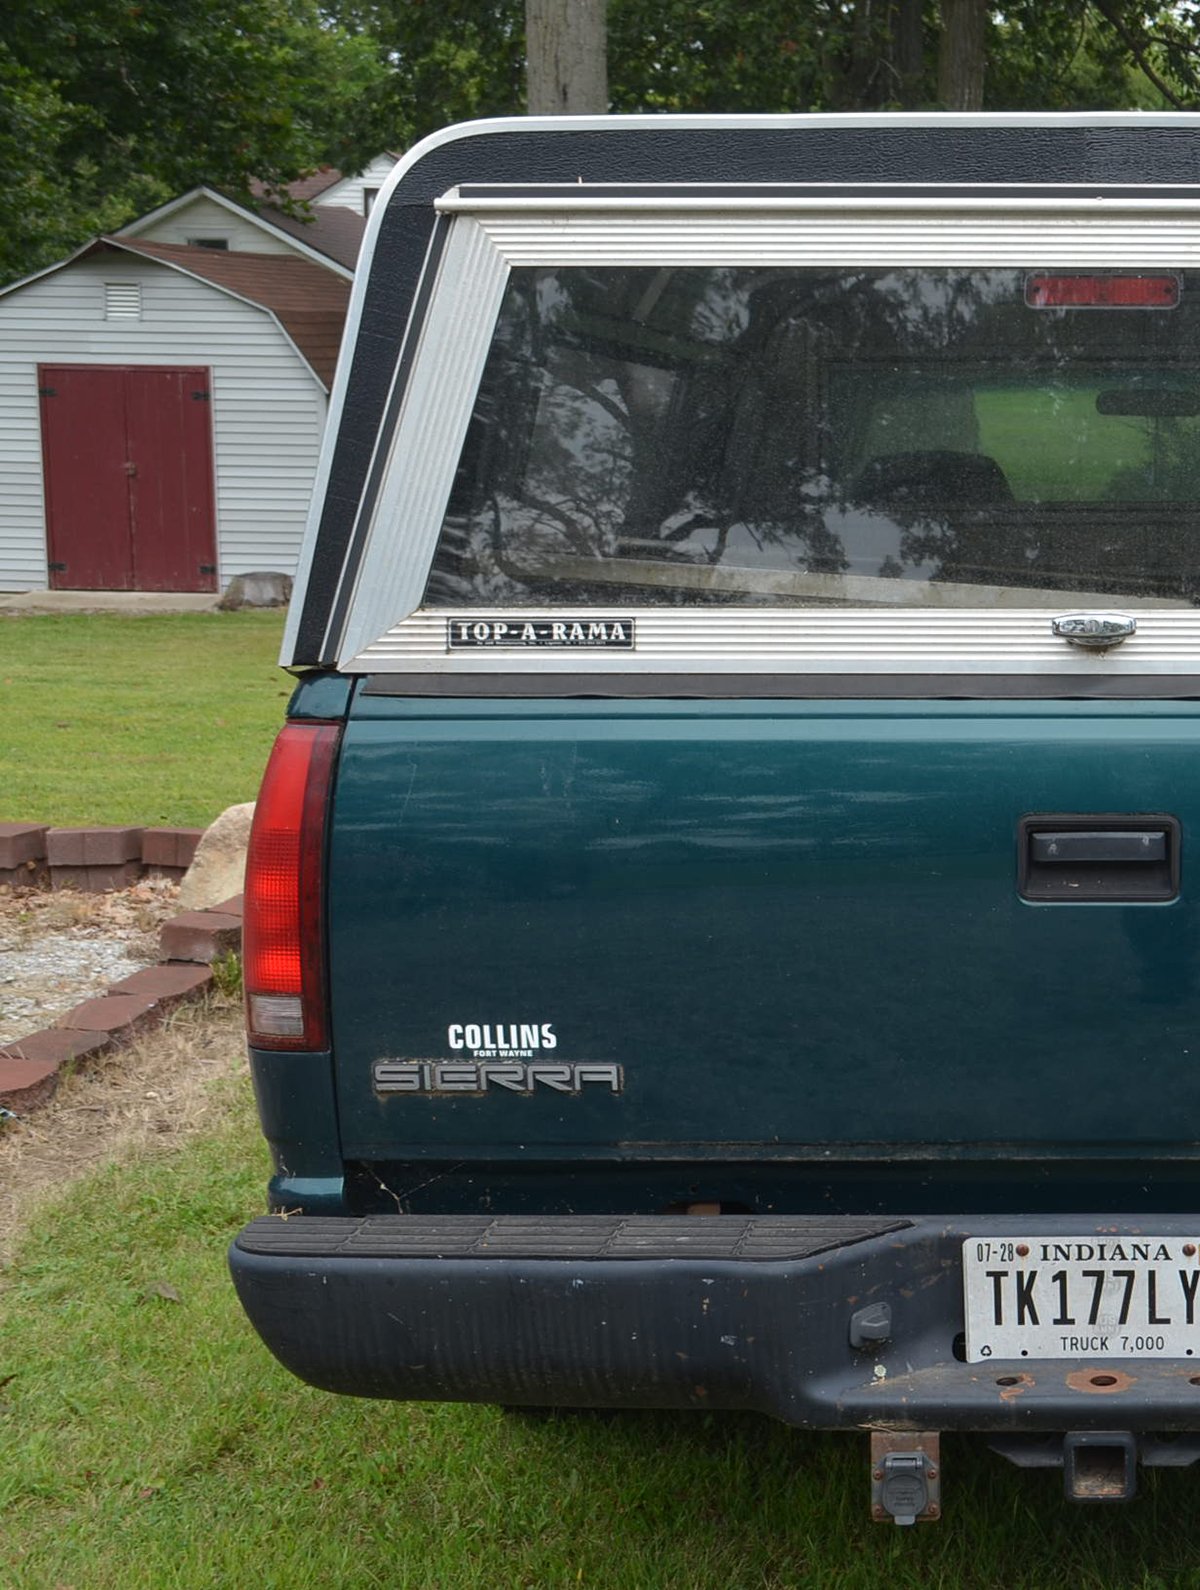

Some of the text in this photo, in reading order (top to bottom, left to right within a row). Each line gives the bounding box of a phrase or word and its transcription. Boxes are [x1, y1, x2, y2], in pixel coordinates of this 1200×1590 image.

[457, 622, 627, 641] TOP-A-RAMA
[448, 1023, 557, 1050] COLLINS
[473, 1050, 533, 1058] FORT WAYNE
[373, 1062, 620, 1092] SIERRA
[976, 1242, 1014, 1263] 07-28
[1039, 1243, 1174, 1262] INDIANA
[1060, 1336, 1165, 1352] TRUCK 7,000
